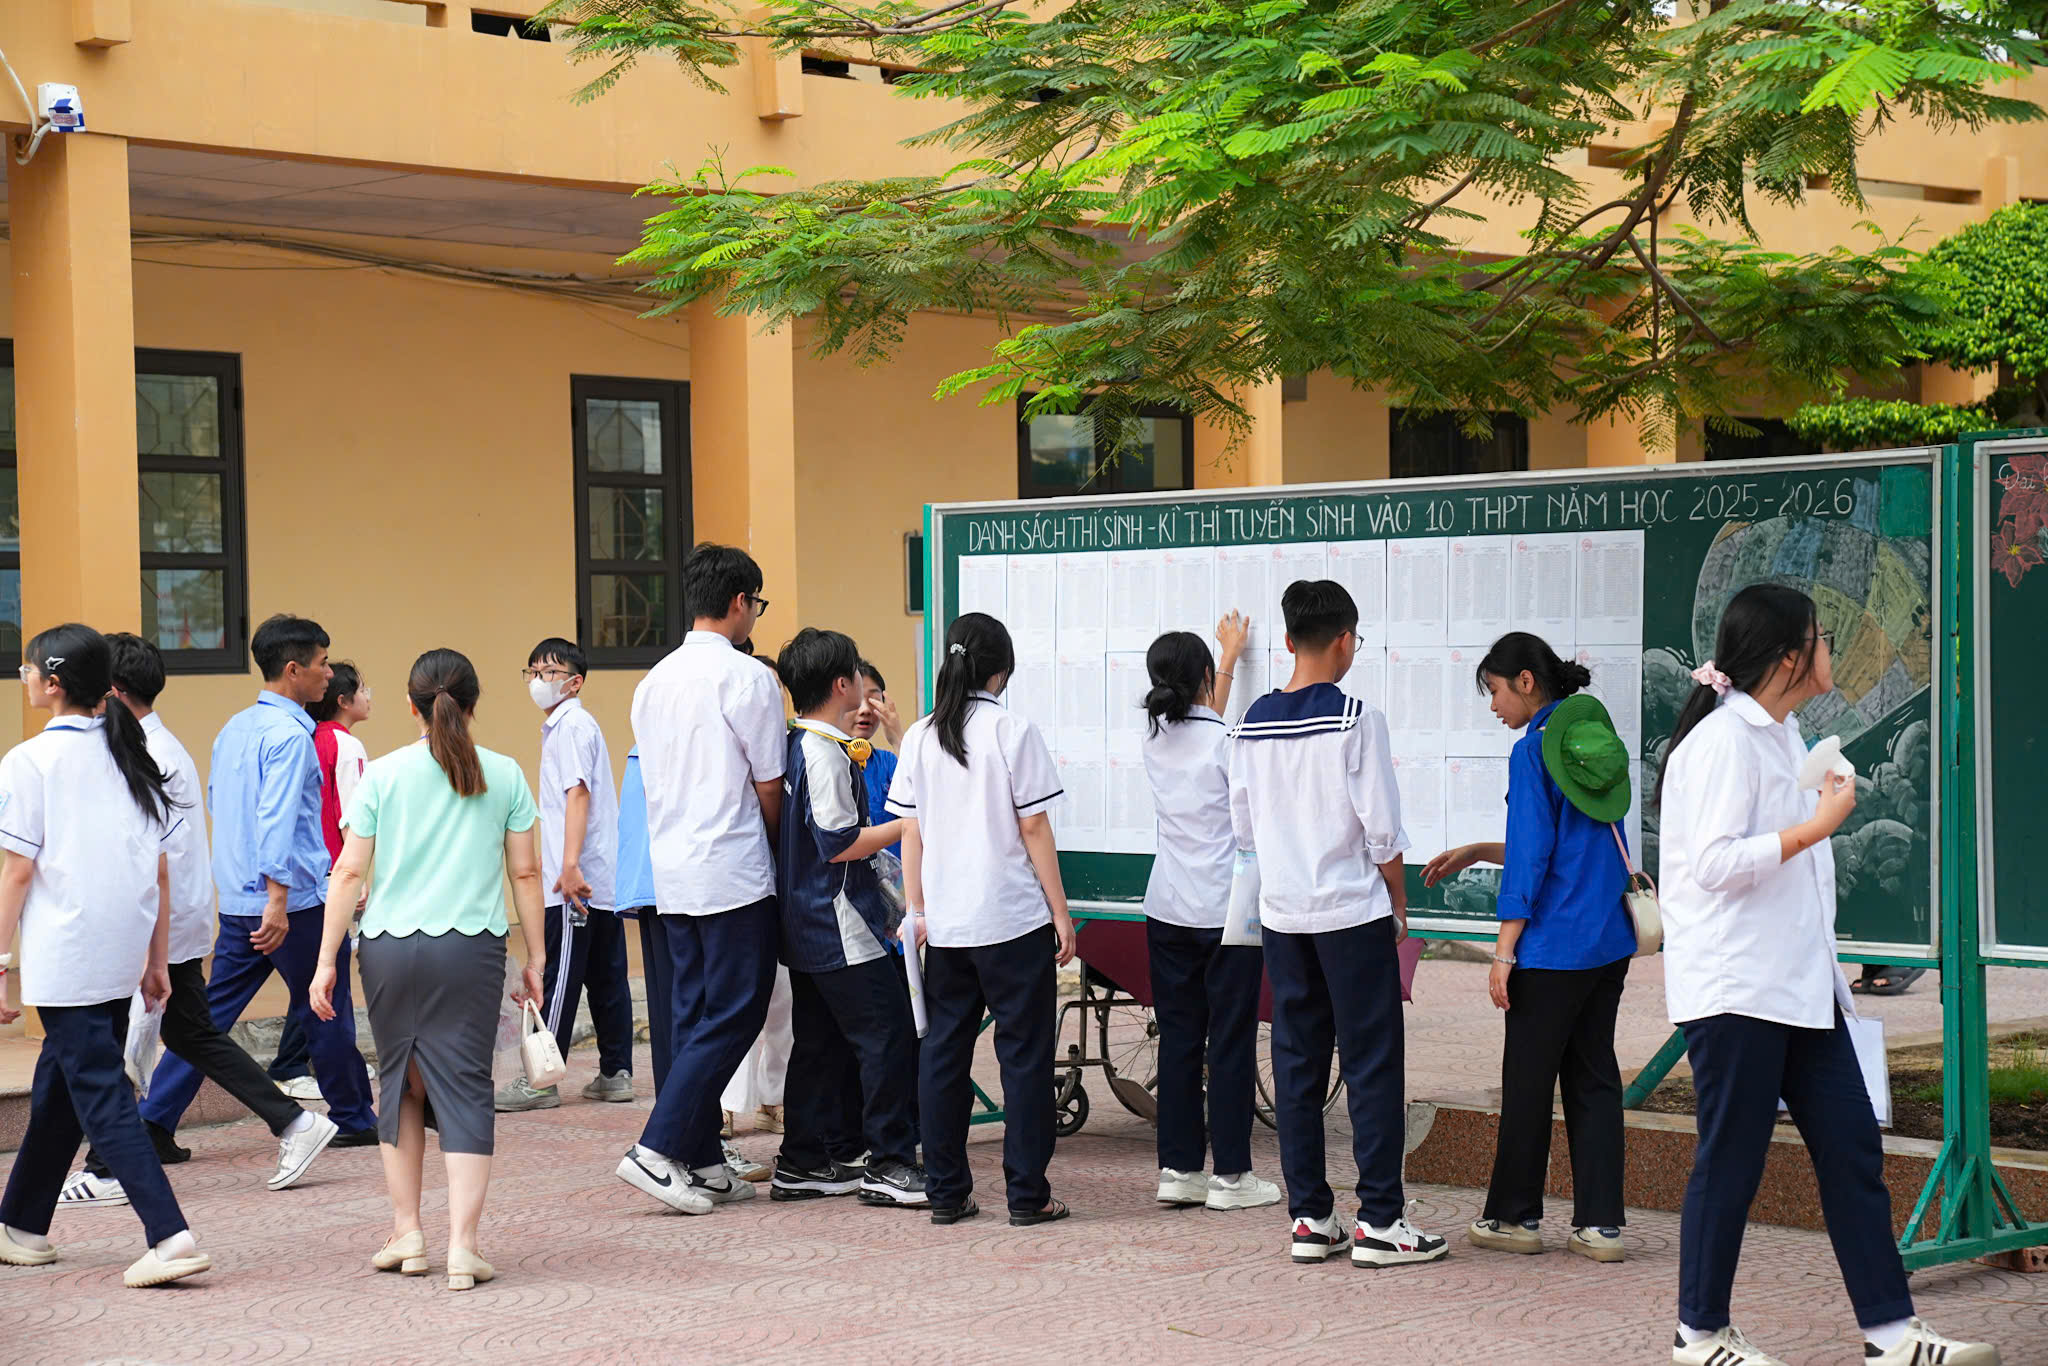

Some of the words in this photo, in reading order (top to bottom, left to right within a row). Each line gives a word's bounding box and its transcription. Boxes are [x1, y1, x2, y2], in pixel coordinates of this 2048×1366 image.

[969, 520, 1016, 552] DANH
[1019, 511, 1065, 549] SÁCH
[1067, 508, 1102, 547] THÍ
[1101, 510, 1142, 548] SINH
[1158, 505, 1181, 543] KÌ
[1184, 504, 1220, 543] THI
[1306, 499, 1355, 537] SINH
[1366, 495, 1411, 533] VÀO
[1425, 500, 1455, 532] 10
[1464, 495, 1533, 530] THPT
[1546, 485, 1608, 528] NĂM
[1620, 489, 1679, 528] HỌC
